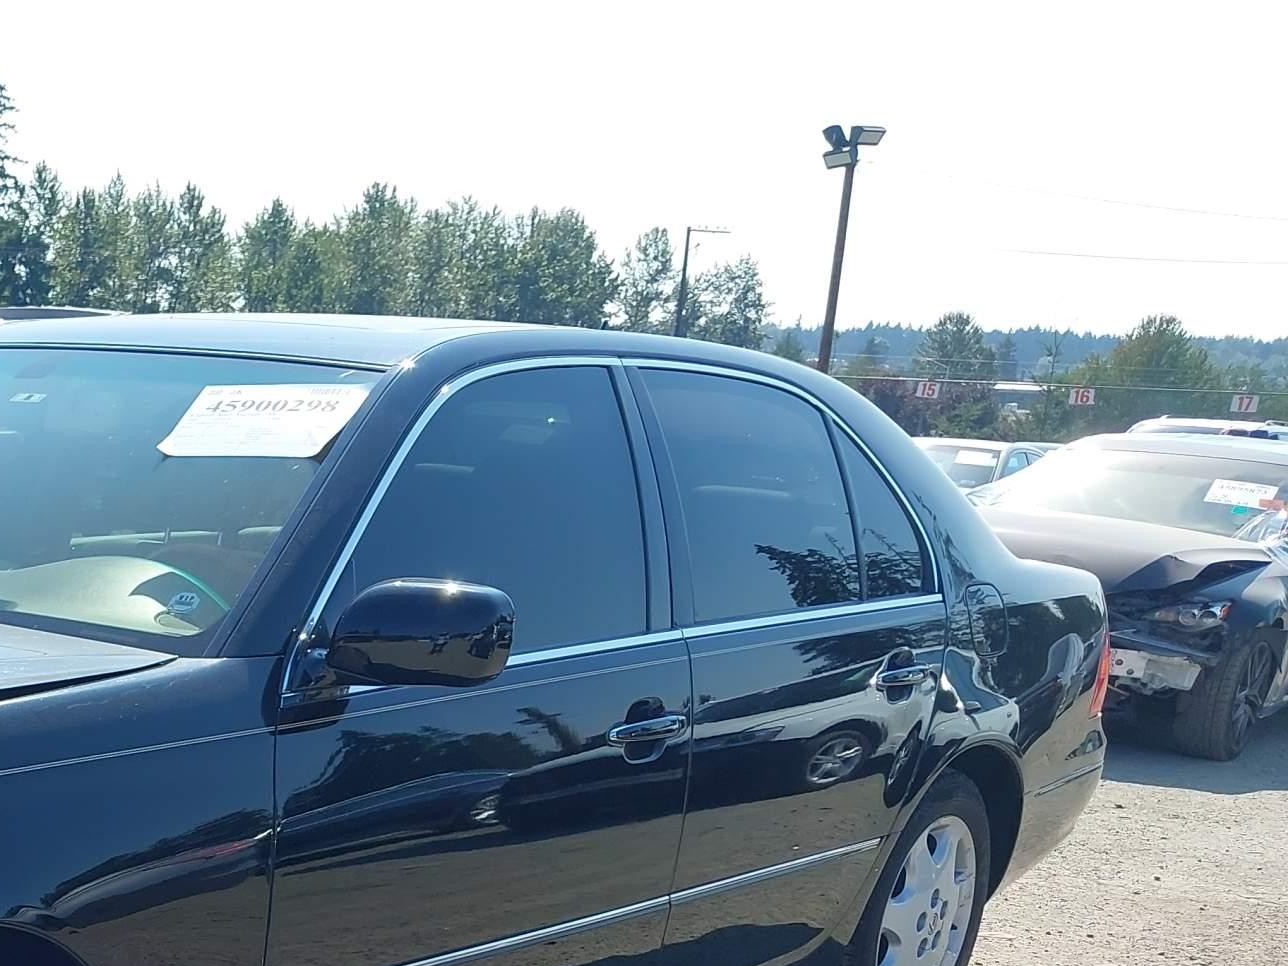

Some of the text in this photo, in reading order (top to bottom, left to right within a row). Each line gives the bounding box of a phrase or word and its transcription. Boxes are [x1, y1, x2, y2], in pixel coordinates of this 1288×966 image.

[920, 383, 936, 398] 15
[1073, 389, 1090, 403] 16
[205, 399, 340, 413] 45900298
[1237, 396, 1253, 411] 17
